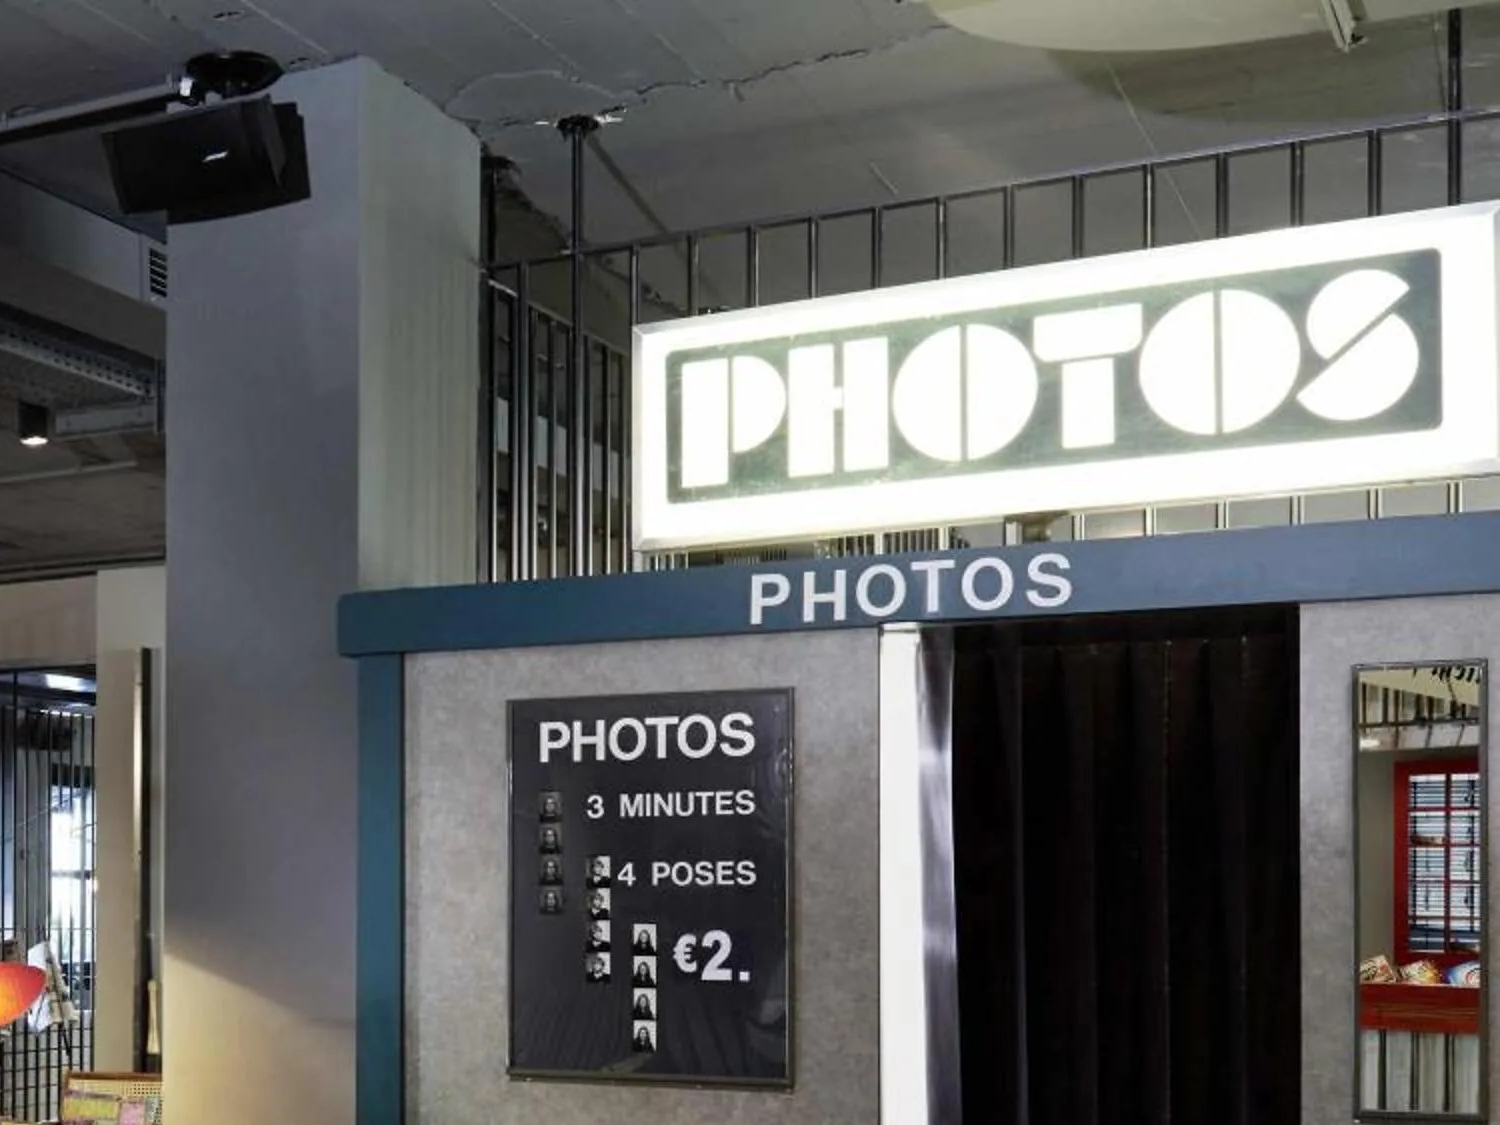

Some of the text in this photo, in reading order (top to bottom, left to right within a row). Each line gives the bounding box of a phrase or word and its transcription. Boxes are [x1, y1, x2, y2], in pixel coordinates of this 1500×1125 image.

[681, 268, 1421, 490] PHOTOS
[750, 552, 1073, 626] PHOTOS
[538, 712, 756, 763] PHOTOS
[587, 789, 756, 819] 3 MINUTES
[617, 861, 757, 886] 4 POSES
